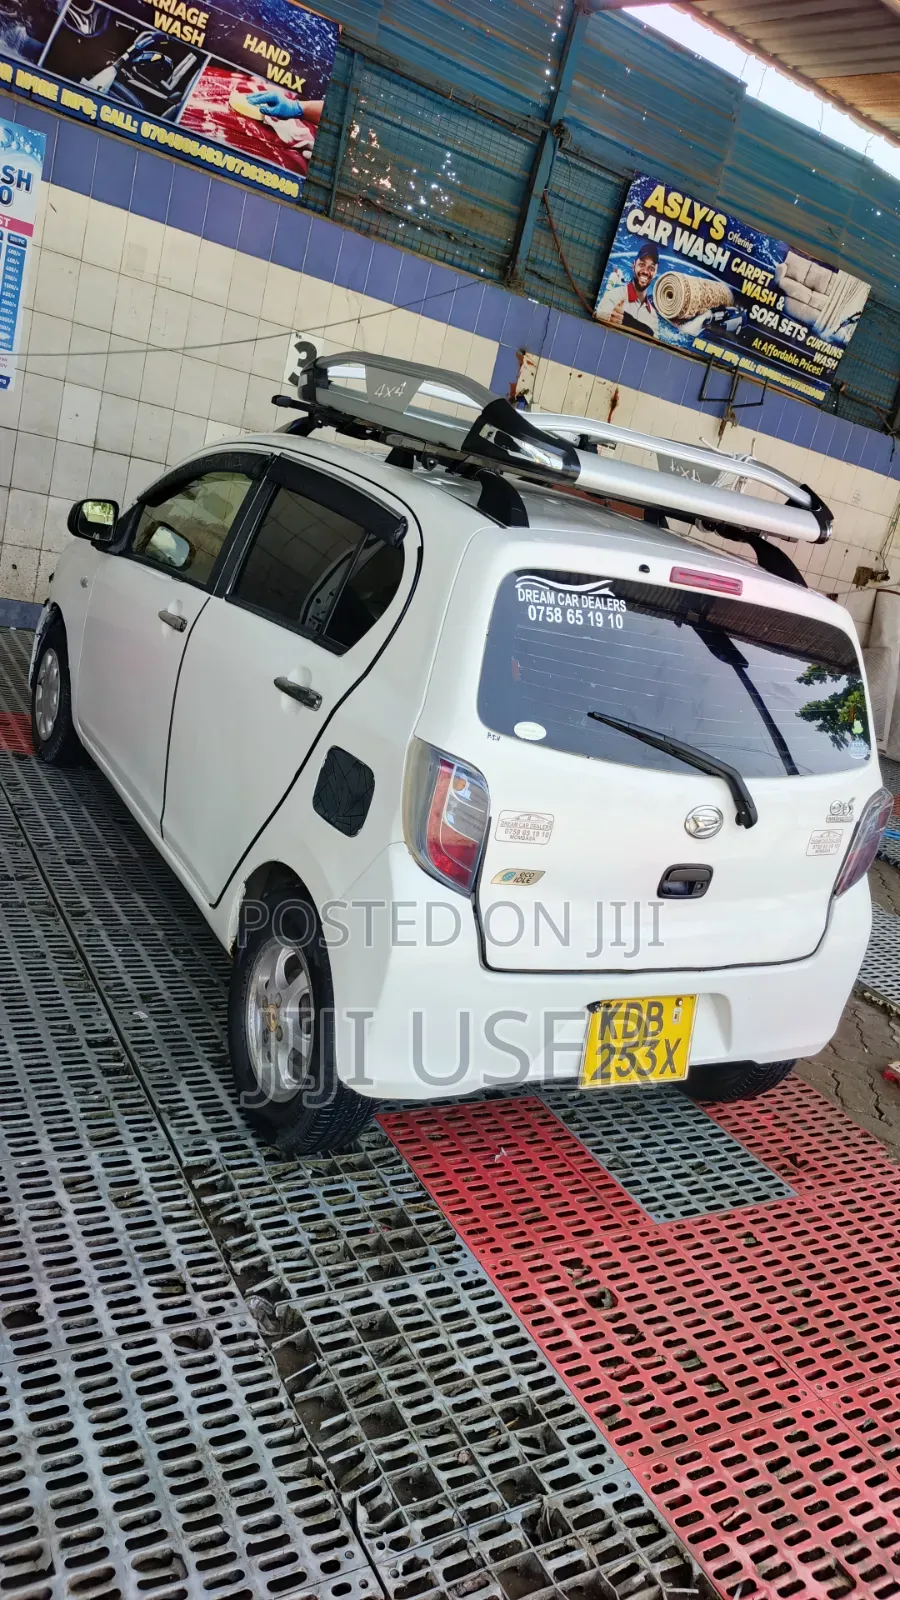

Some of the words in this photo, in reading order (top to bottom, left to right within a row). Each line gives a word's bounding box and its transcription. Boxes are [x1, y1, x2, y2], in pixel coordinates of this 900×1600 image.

[153, 11, 206, 48] WASH
[243, 34, 291, 67] HAND
[266, 63, 306, 94] WAX
[644, 184, 727, 240] ASLY'S
[626, 208, 672, 246] CAR
[673, 227, 731, 273] WASH
[727, 231, 753, 253] Offering
[731, 257, 774, 287] CARPET
[741, 279, 778, 307] WASH
[776, 296, 785, 311] &
[749, 304, 780, 330] SOFA
[778, 318, 808, 342] SETS
[751, 337, 762, 349] At
[760, 342, 800, 367] Affordable
[798, 358, 825, 376] Prices!
[806, 335, 844, 359] CURTAINS
[813, 351, 839, 370] WASH
[288, 341, 317, 386] 3
[374, 381, 407, 398] 4x4
[517, 588, 556, 605] DREAM
[557, 593, 579, 608] CAR
[581, 596, 627, 613] DEALERS
[527, 605, 562, 623] 0758
[566, 609, 584, 625] 65
[587, 612, 604, 628] 19
[608, 614, 623, 629] 10
[598, 1001, 664, 1041] KDB
[590, 1037, 682, 1081] 253X
